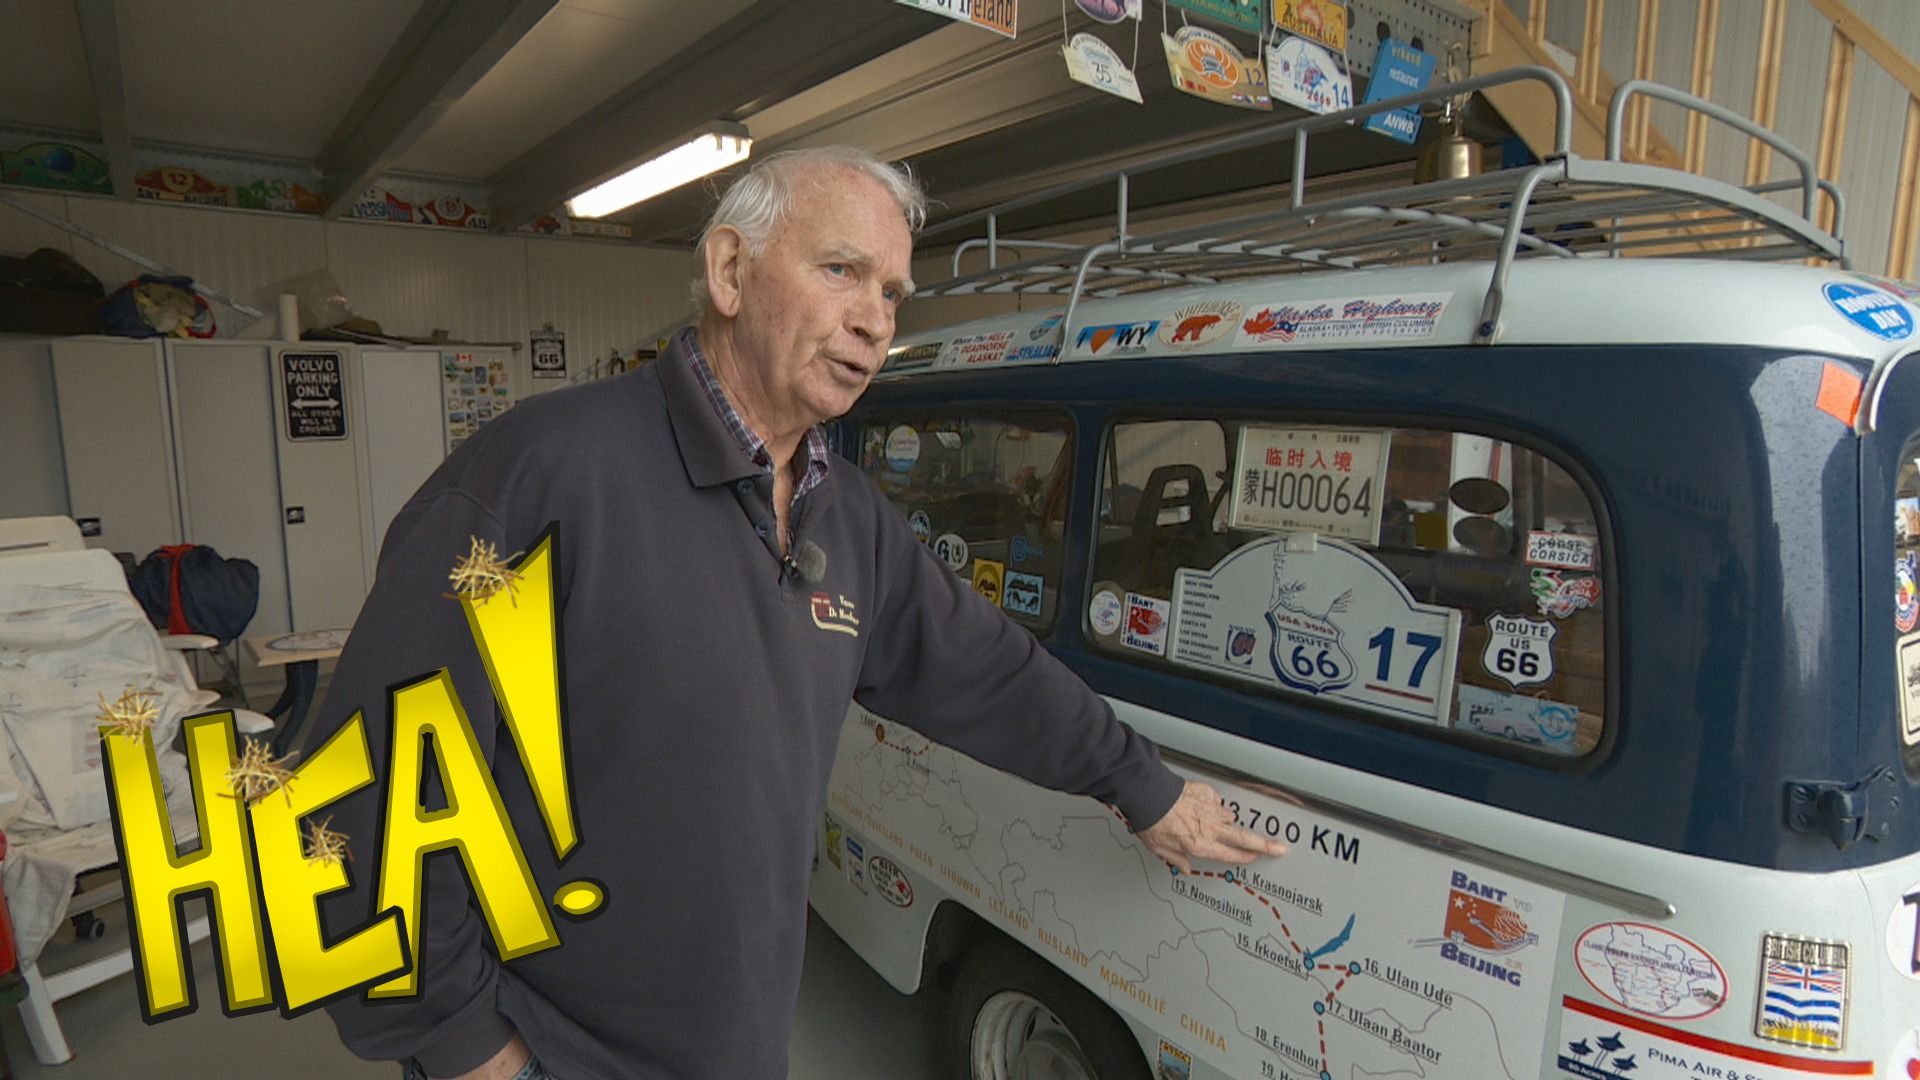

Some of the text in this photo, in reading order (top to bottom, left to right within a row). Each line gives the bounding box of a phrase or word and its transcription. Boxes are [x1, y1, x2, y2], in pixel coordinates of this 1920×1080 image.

[1281, 13, 1339, 49] AUSTRALIA
[1244, 67, 1264, 87] 12
[1332, 81, 1350, 108] 14
[1383, 112, 1416, 134] ANWB
[166, 172, 188, 187] 12
[1343, 298, 1443, 323] Highway
[1117, 325, 1153, 347] WY
[1299, 324, 1326, 333] ALASKA
[288, 359, 335, 372] VOLVO
[538, 352, 558, 366] 66
[288, 371, 339, 385] PARKING
[295, 385, 332, 398] ONLY
[1265, 446, 1354, 472] 临时入境
[1529, 548, 1589, 564] CORSICA
[1277, 613, 1300, 626] USA
[1495, 620, 1550, 637] ROUTE
[1287, 634, 1331, 649] ROUTE
[1510, 638, 1531, 650] US
[1292, 645, 1340, 678] 66
[1368, 627, 1443, 688] 17
[1497, 649, 1540, 677] 66
[1220, 797, 1361, 865] 3.700 KM
[1234, 866, 1324, 913] 14. Krasnojarsk
[1450, 870, 1508, 902] BANT
[1174, 879, 1254, 921] 13. Novosibirsk
[1236, 931, 1303, 974] 15. Irkoetsk
[1440, 942, 1522, 987] BEIJING
[988, 896, 1028, 931] LETLAND
[1037, 927, 1089, 968] RUSLAND
[1099, 965, 1168, 1014] MONGOLIË
[1179, 1013, 1227, 1052] CHINA
[1363, 957, 1453, 1005] 16. Ulan Ude
[1327, 1000, 1442, 1062] 17. Ulaan Baator
[1253, 1025, 1321, 1069] 18. Erenhot
[1648, 1047, 1689, 1070] PIMA
[1692, 1061, 1722, 1077] AIR
